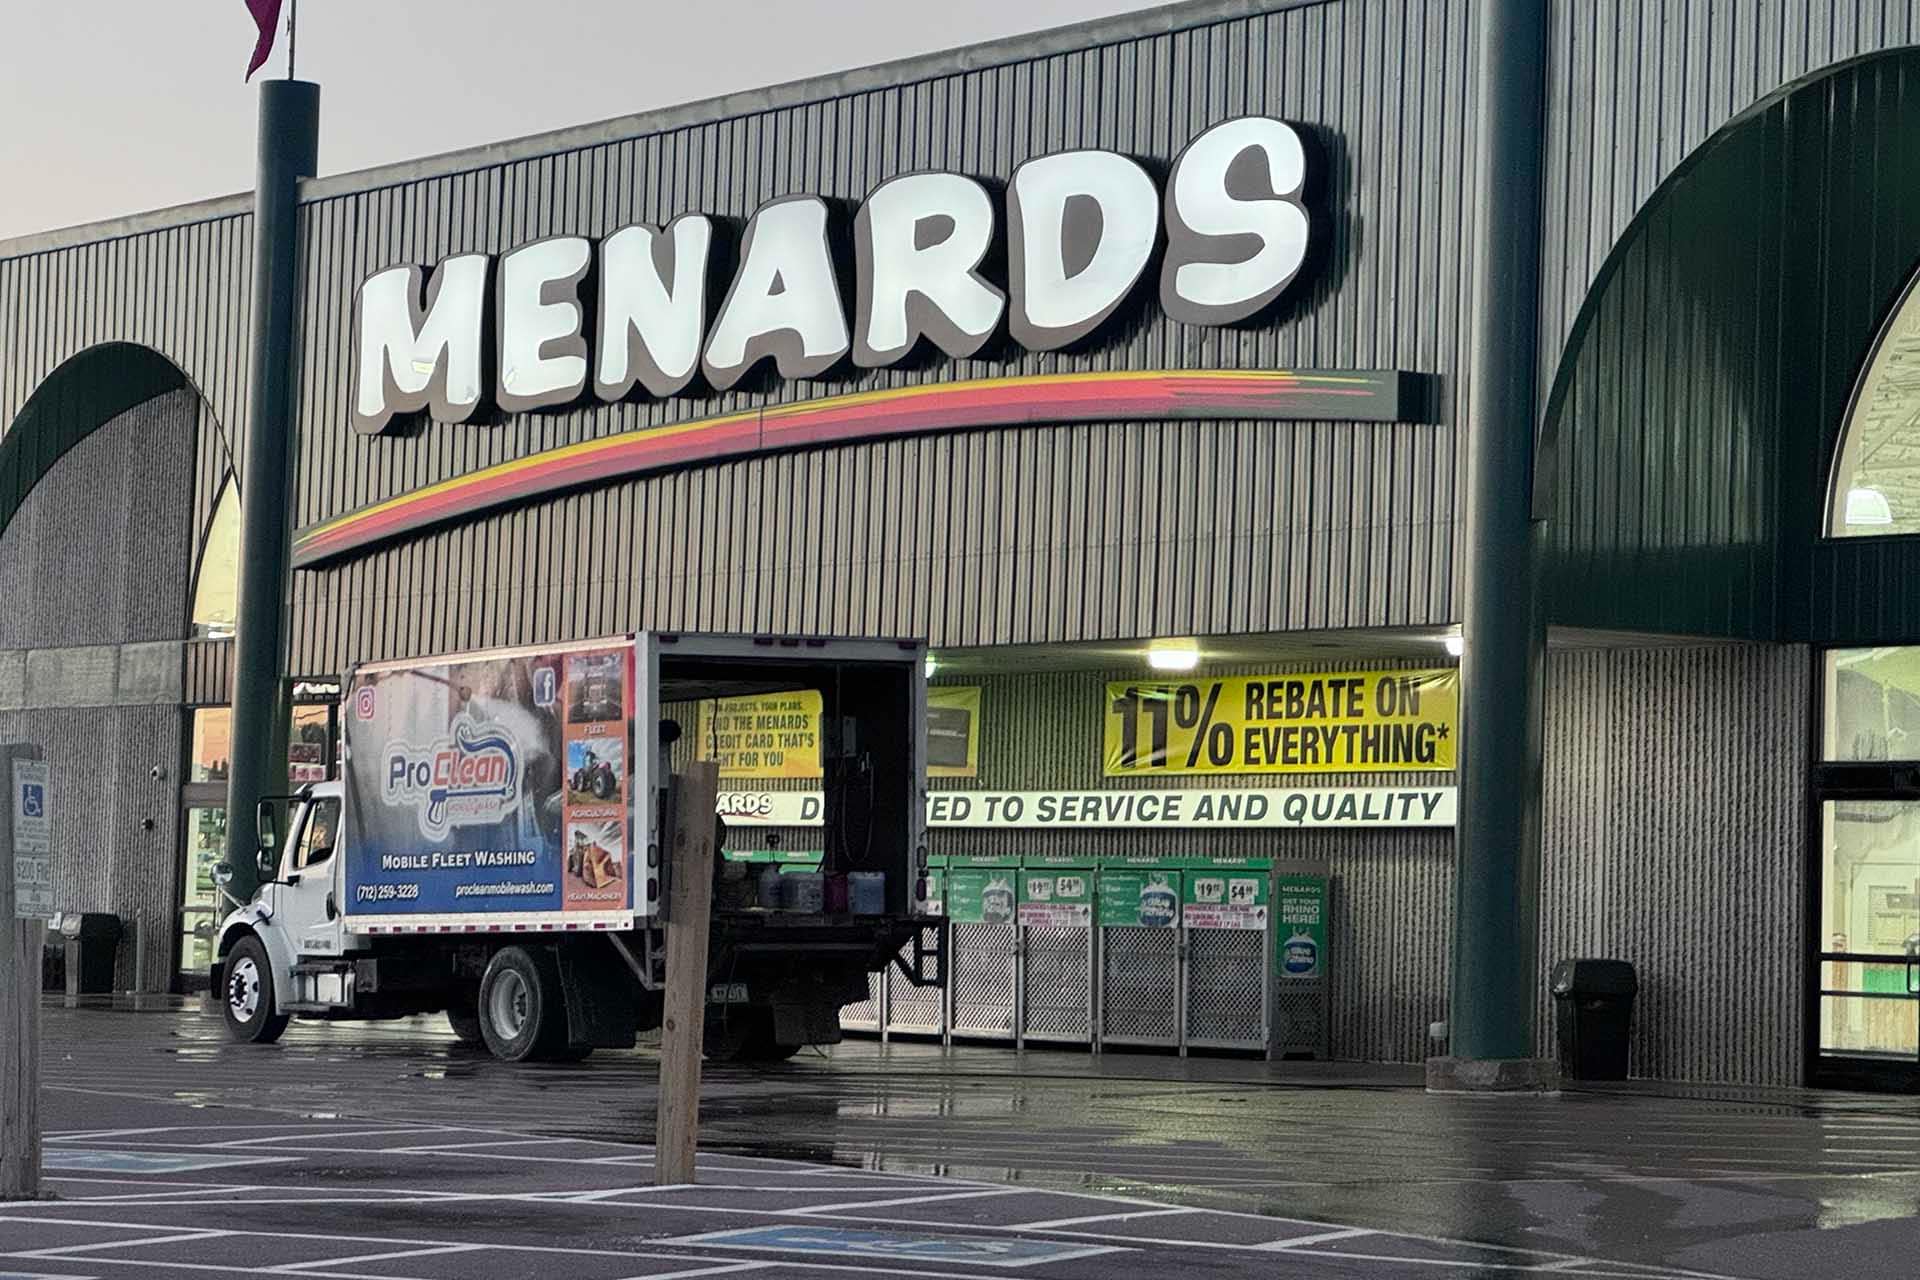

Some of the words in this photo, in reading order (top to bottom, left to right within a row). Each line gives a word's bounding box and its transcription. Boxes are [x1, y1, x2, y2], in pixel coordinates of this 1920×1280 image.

[355, 115, 1310, 434] MENARDS
[1244, 678, 1365, 721] REBATE
[1376, 676, 1420, 717] ON
[706, 716, 730, 731] FND
[733, 715, 753, 730] THE
[757, 713, 809, 729] MENARDS
[1112, 682, 1234, 768] 11%
[706, 734, 742, 748] CEDIT
[745, 732, 774, 748] CARD
[778, 731, 815, 748] THAT'S
[739, 751, 759, 766] FOR
[763, 750, 784, 766] YOU
[390, 751, 507, 789] ProClean
[716, 793, 775, 815] ARDS
[929, 796, 971, 821] ED
[984, 796, 1024, 821] TO
[1036, 795, 1183, 822] SERVICE
[1192, 794, 1268, 822] AND
[1283, 793, 1443, 824] QUALITY
[382, 855, 428, 870] MOBILE
[432, 853, 471, 868] FLEET
[475, 851, 536, 866] WASHING
[357, 885, 377, 901] (712)
[456, 882, 554, 898] procleanmobilewash.com
[1283, 905, 1320, 914] RHINO
[1283, 914, 1320, 925] HERE!
